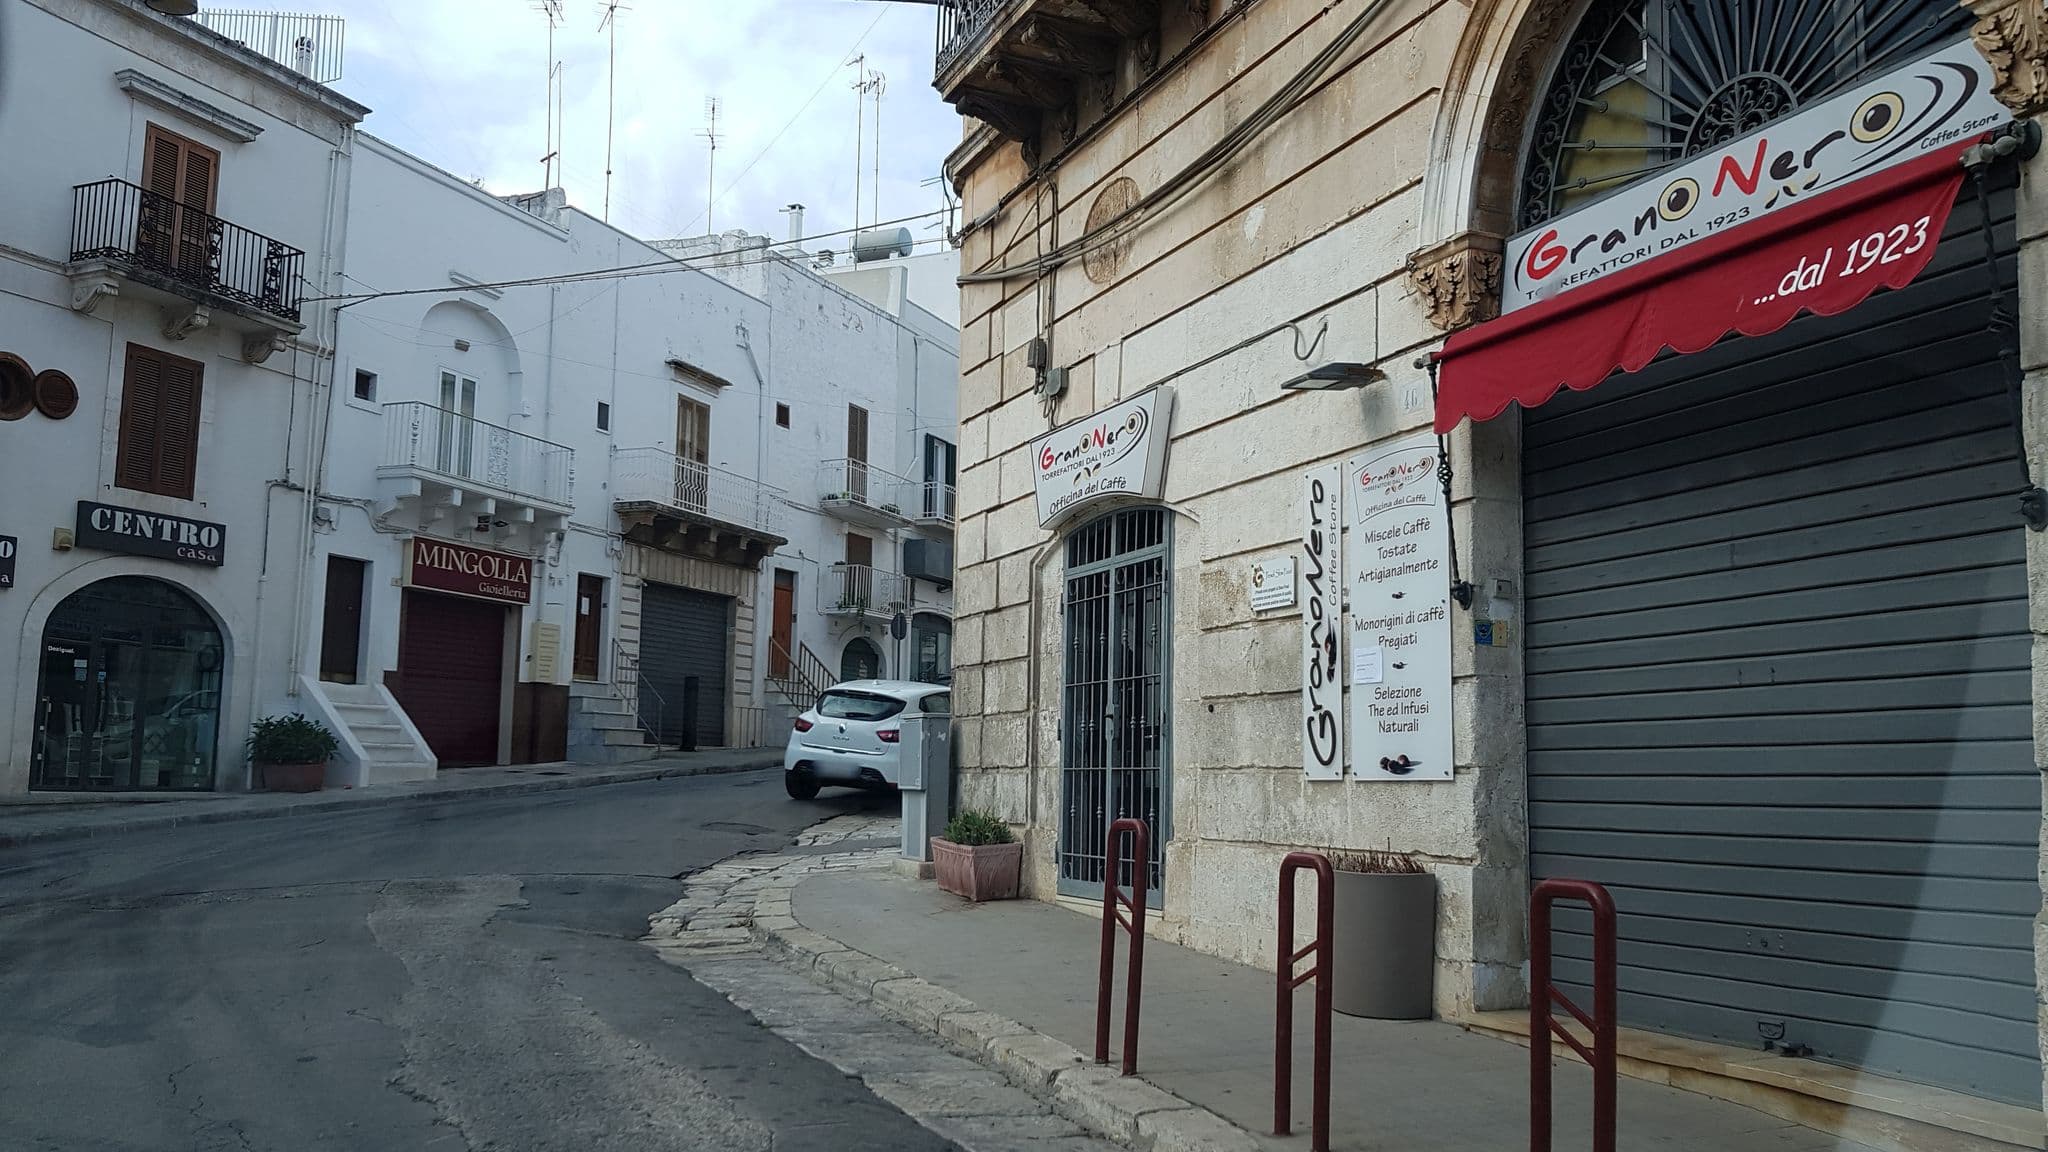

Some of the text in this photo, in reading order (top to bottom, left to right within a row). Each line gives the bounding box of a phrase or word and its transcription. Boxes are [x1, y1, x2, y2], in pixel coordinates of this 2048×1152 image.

[1921, 112, 2000, 150] Coffee Store
[1660, 228, 1699, 249] DAL
[1706, 206, 1751, 231] 1923
[1839, 215, 1930, 277] 1923
[1042, 460, 1085, 481] TORREFATTORI
[1049, 476, 1127, 515] Officina del Caffè
[1365, 493, 1426, 516] Officina del Caffè
[91, 508, 219, 548] CENTRO
[1364, 517, 1431, 544] Miscele Caffè
[177, 547, 217, 562] casa
[1328, 494, 1337, 606] Coffee Store
[1377, 543, 1417, 560] Tostate
[416, 542, 529, 584] MINGOLLA
[1358, 559, 1439, 584] Artigianalmente
[478, 582, 527, 600] Gioielleria
[1355, 606, 1445, 632] Monorigini di caffè
[1378, 632, 1418, 650] Pregiati
[1374, 686, 1422, 700] Selezione
[1368, 700, 1429, 717] The ed Infusi
[1378, 718, 1419, 733] Naturali
